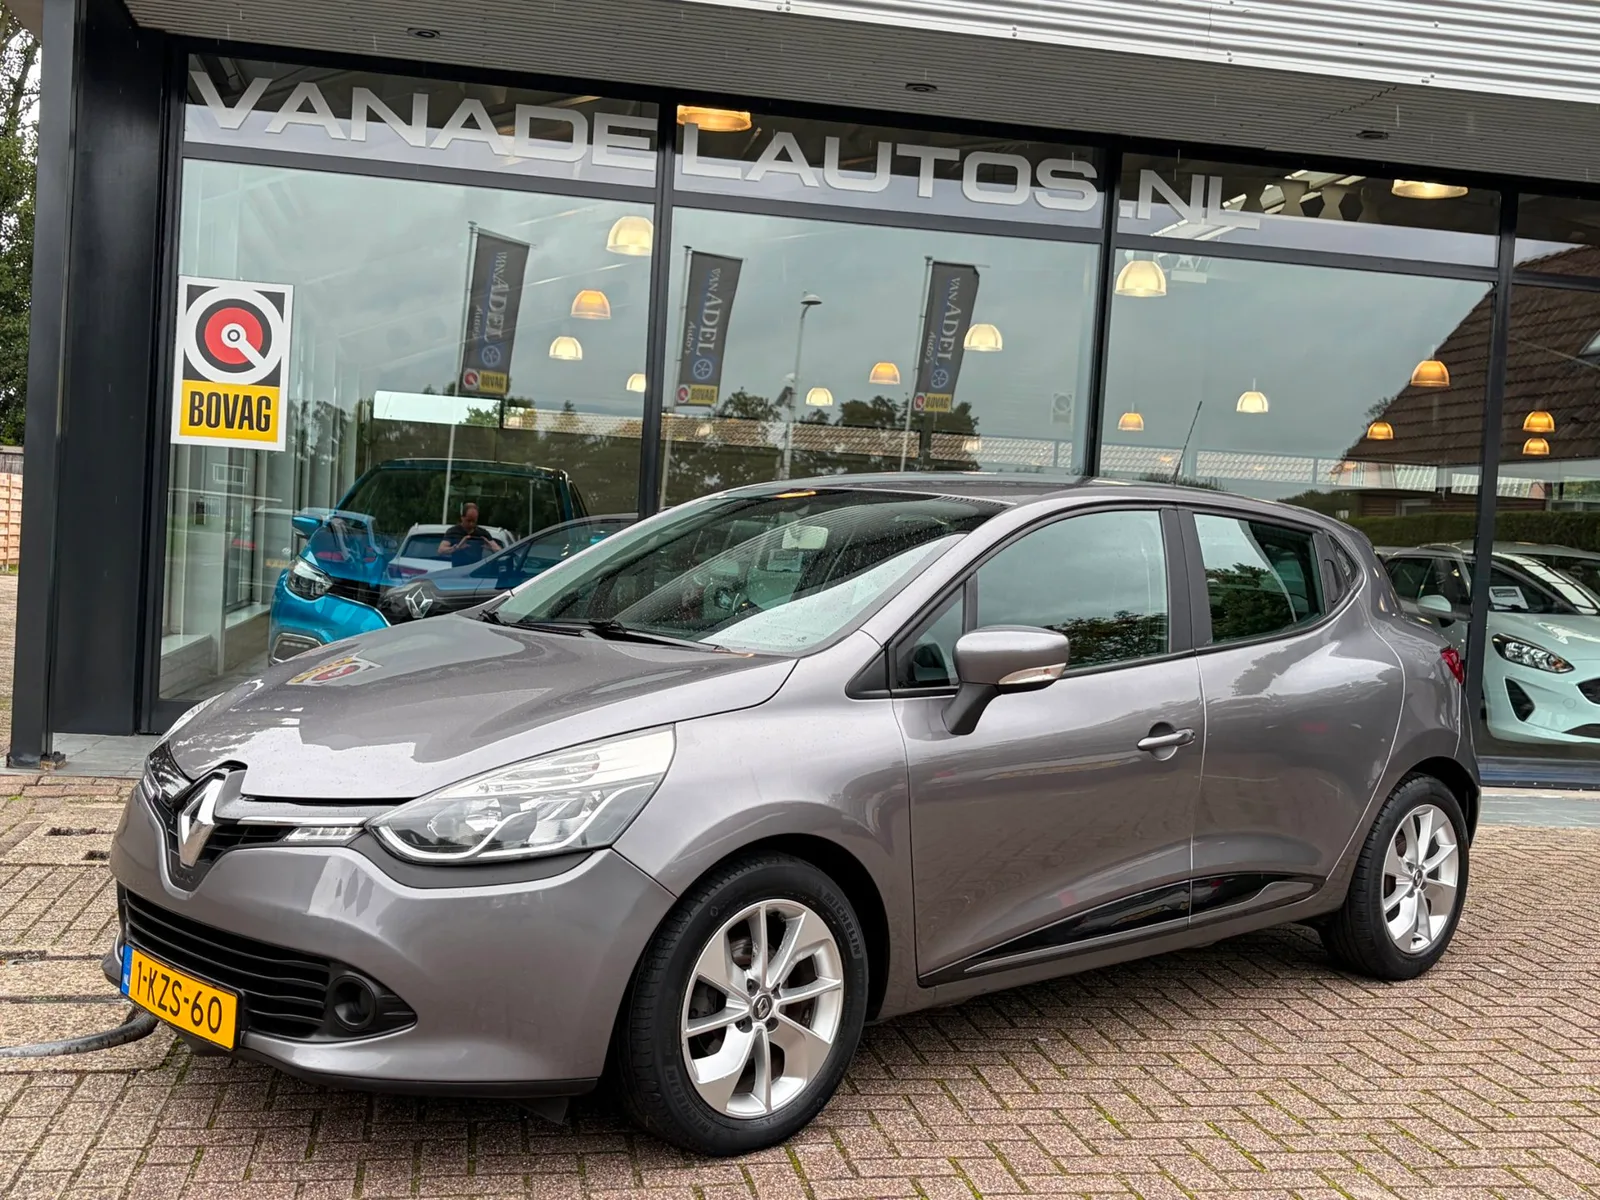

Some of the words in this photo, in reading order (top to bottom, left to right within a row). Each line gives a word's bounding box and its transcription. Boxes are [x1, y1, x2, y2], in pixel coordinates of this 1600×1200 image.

[188, 390, 272, 432] BOVAG
[823, 892, 861, 956] MICHELIN
[137, 961, 222, 1034] 1-KZS-60
[666, 1069, 712, 1134] MICHELIN
